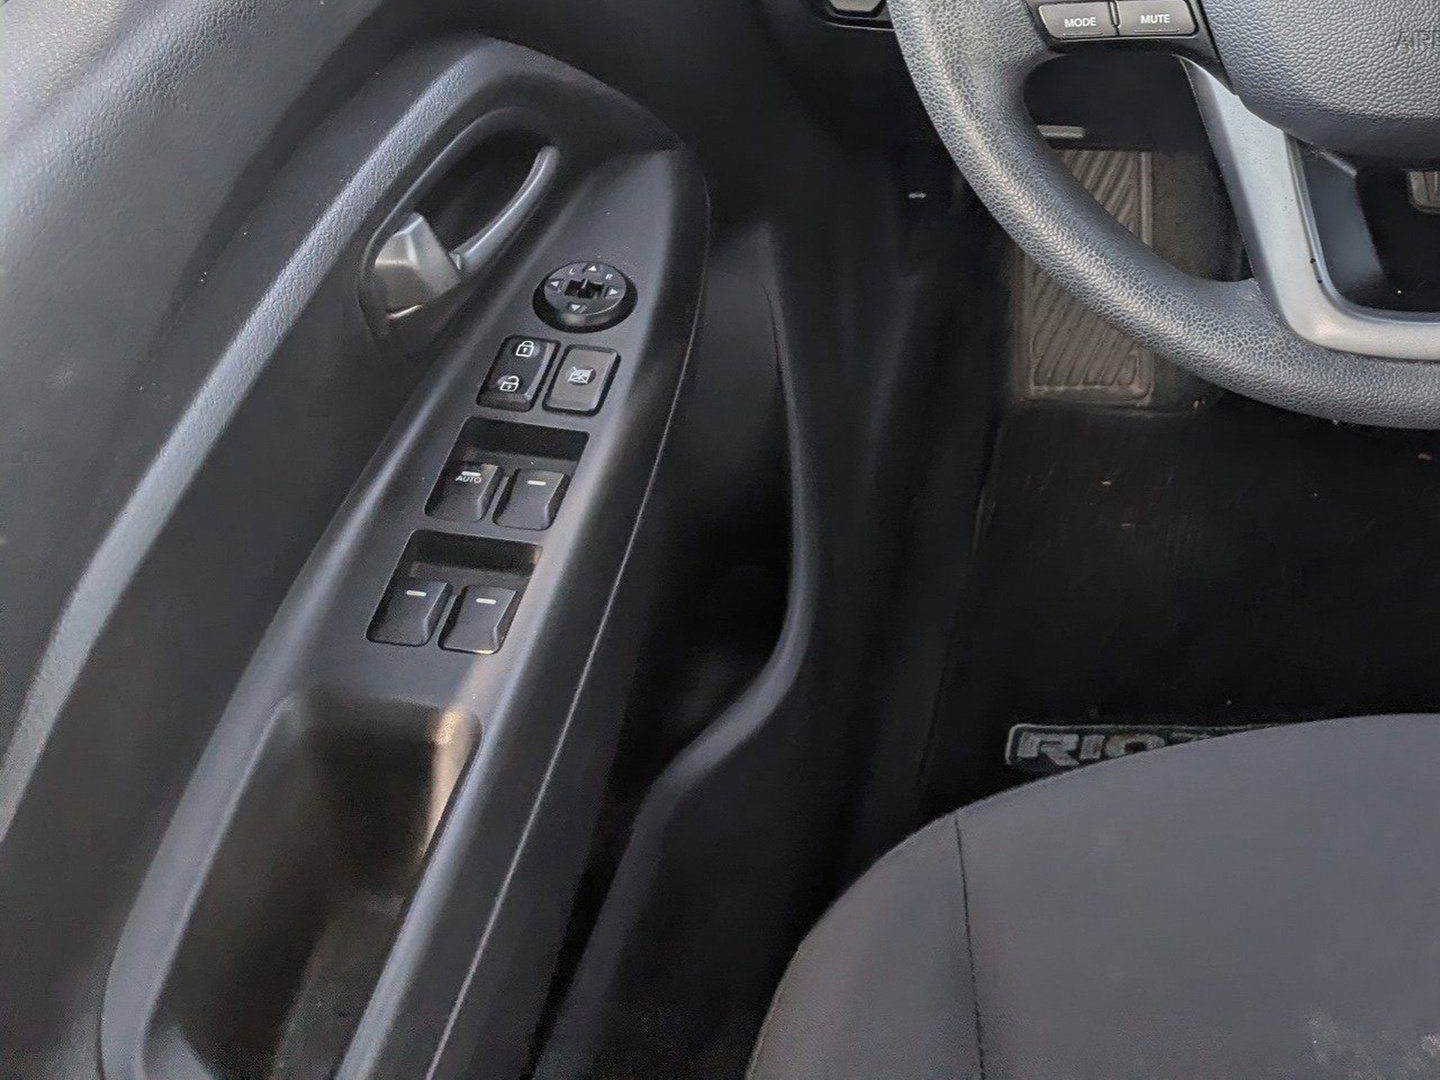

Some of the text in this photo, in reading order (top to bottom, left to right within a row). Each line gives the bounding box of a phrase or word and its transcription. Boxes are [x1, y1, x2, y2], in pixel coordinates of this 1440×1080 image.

[1064, 17, 1097, 28] MODE
[1140, 14, 1171, 24] MUTE
[455, 475, 482, 484] AUTO
